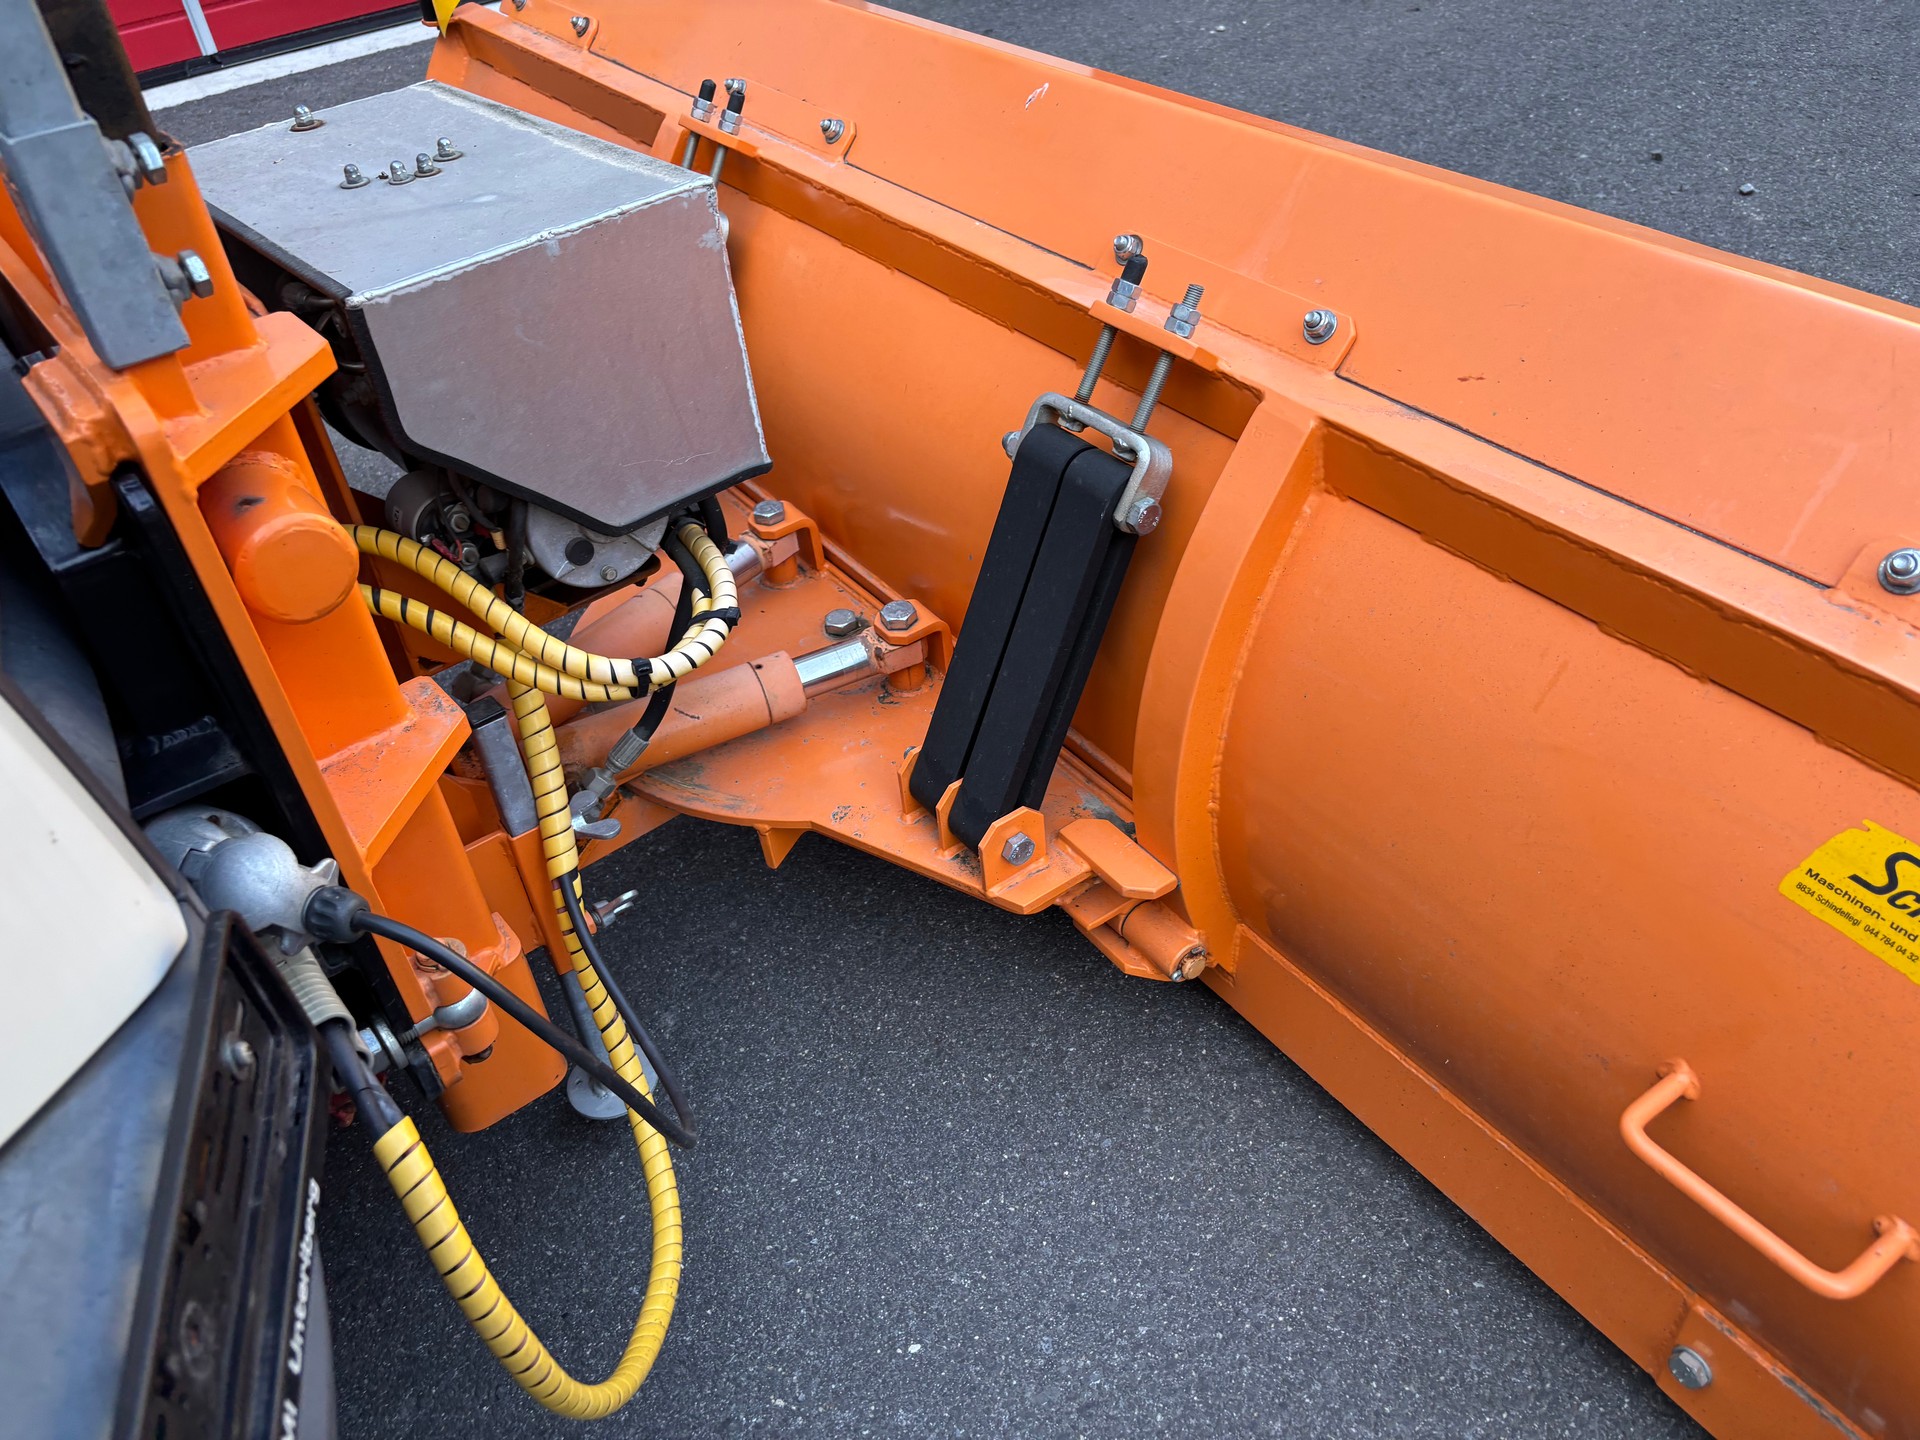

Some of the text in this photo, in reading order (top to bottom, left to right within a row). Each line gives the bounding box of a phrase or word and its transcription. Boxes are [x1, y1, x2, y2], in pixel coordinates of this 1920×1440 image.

[1796, 882, 1919, 963] 8834 Schindellegi 044 784 04 32
[1805, 868, 1919, 943] Maschinen- und
